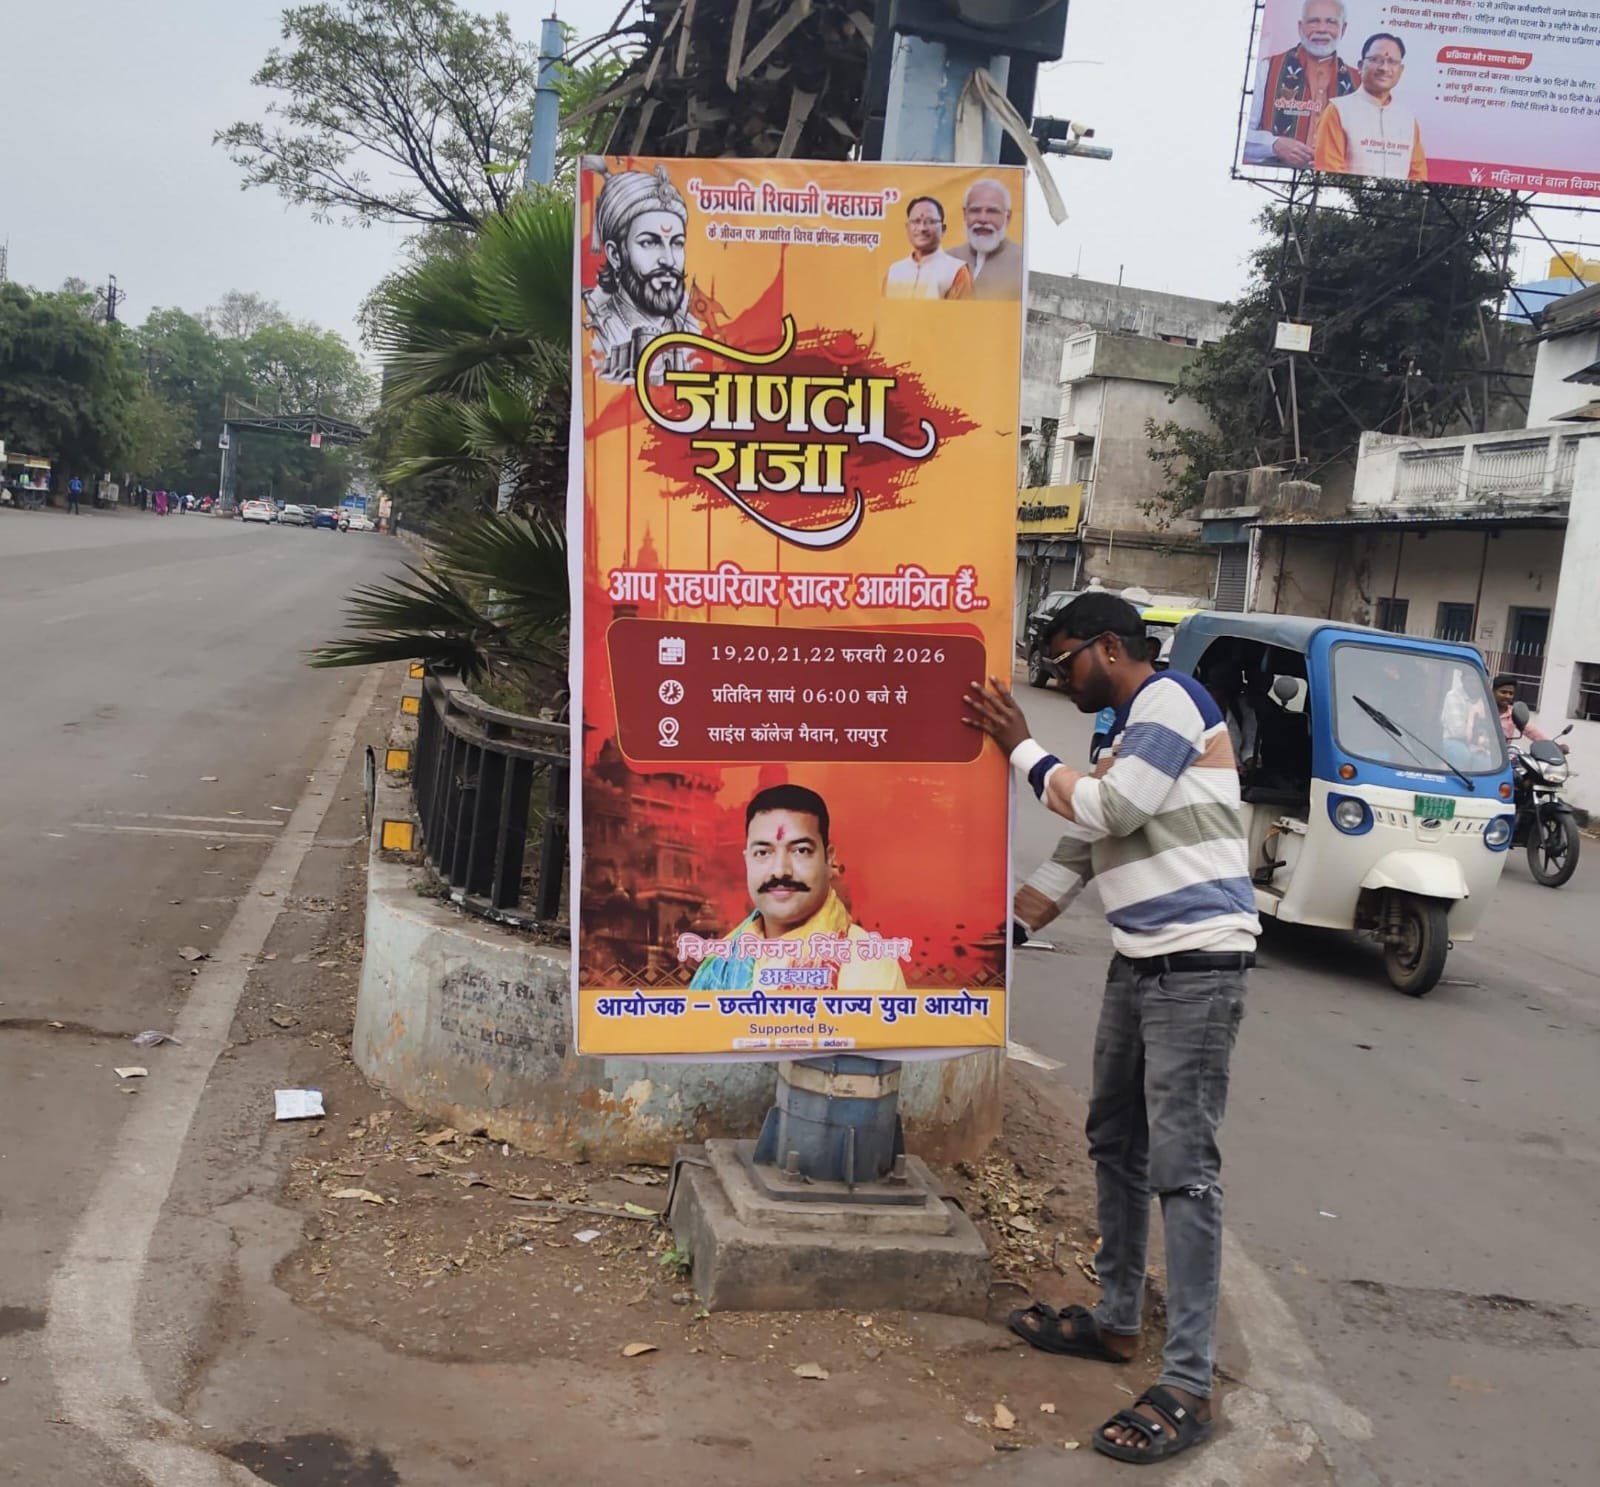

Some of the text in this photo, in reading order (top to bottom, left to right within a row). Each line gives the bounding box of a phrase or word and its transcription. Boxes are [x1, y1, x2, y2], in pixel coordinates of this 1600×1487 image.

[1490, 169, 1525, 185] महिला
[1527, 173, 1543, 187] एवं
[1545, 178, 1568, 189] बाल
[762, 183, 820, 215] शिवाजी
[708, 225, 718, 240] के
[719, 226, 742, 240] जीवन
[745, 229, 756, 241] पर
[758, 226, 791, 242] आधारित
[815, 230, 840, 245] प्रसिद्ध
[842, 232, 880, 249] महानाट्य
[608, 570, 658, 602] आप
[663, 562, 783, 606] सहपरिवार
[786, 574, 850, 608] सादर
[855, 565, 950, 608] आमंत्रित
[710, 642, 946, 666] 19,20,21,22 फरवरी 2026
[711, 683, 909, 706] प्रतिदिन सायं 06:00 बजे से
[707, 721, 889, 748] साइंस कॉलेज मैदान, रायपुर
[677, 931, 913, 963] विश्व विजय सिंह तोमर
[758, 966, 832, 986] अध्यक्ष
[596, 992, 687, 1017] आयोजक
[718, 991, 818, 1019] छत्तीसगढ़
[825, 997, 873, 1017] राज्य
[880, 997, 919, 1022] युवा
[924, 989, 990, 1016] आयोग
[749, 1023, 815, 1036] Supported
[824, 1040, 850, 1048] adani
